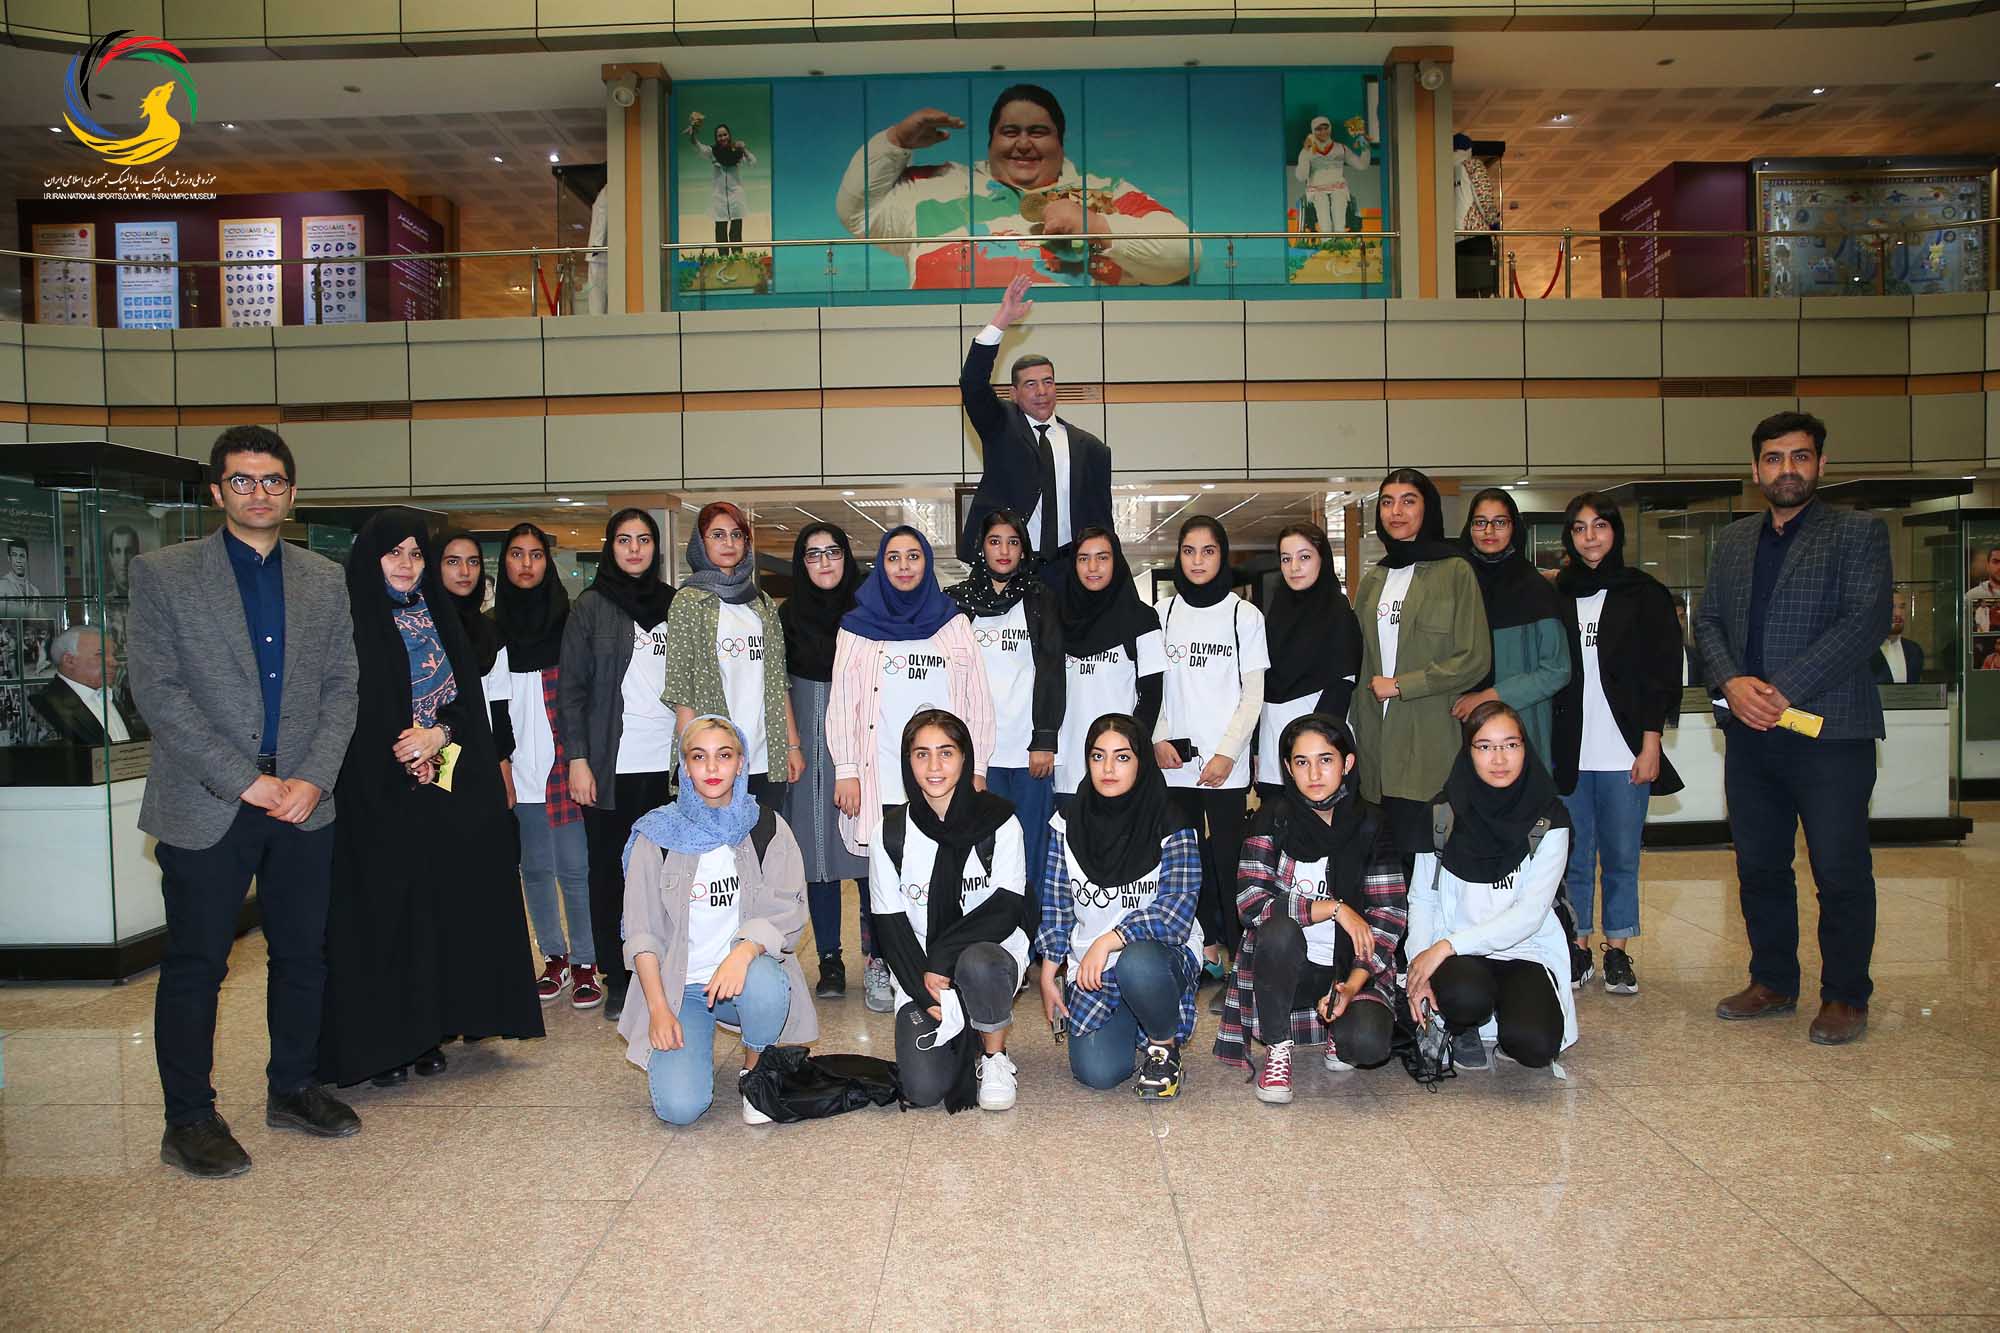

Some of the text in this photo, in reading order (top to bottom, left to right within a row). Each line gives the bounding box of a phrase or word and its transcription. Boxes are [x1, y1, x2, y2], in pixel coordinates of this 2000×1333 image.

[1001, 640, 1019, 652] DAY
[1190, 642, 1233, 657] OLYMPIC
[749, 648, 765, 661] DAY
[1189, 656, 1208, 668] DAY
[908, 667, 928, 680] DAY
[1080, 663, 1096, 675] DAY
[1120, 880, 1157, 895] OLYMPI
[710, 893, 735, 907] DAY
[1121, 896, 1140, 909] DAY
